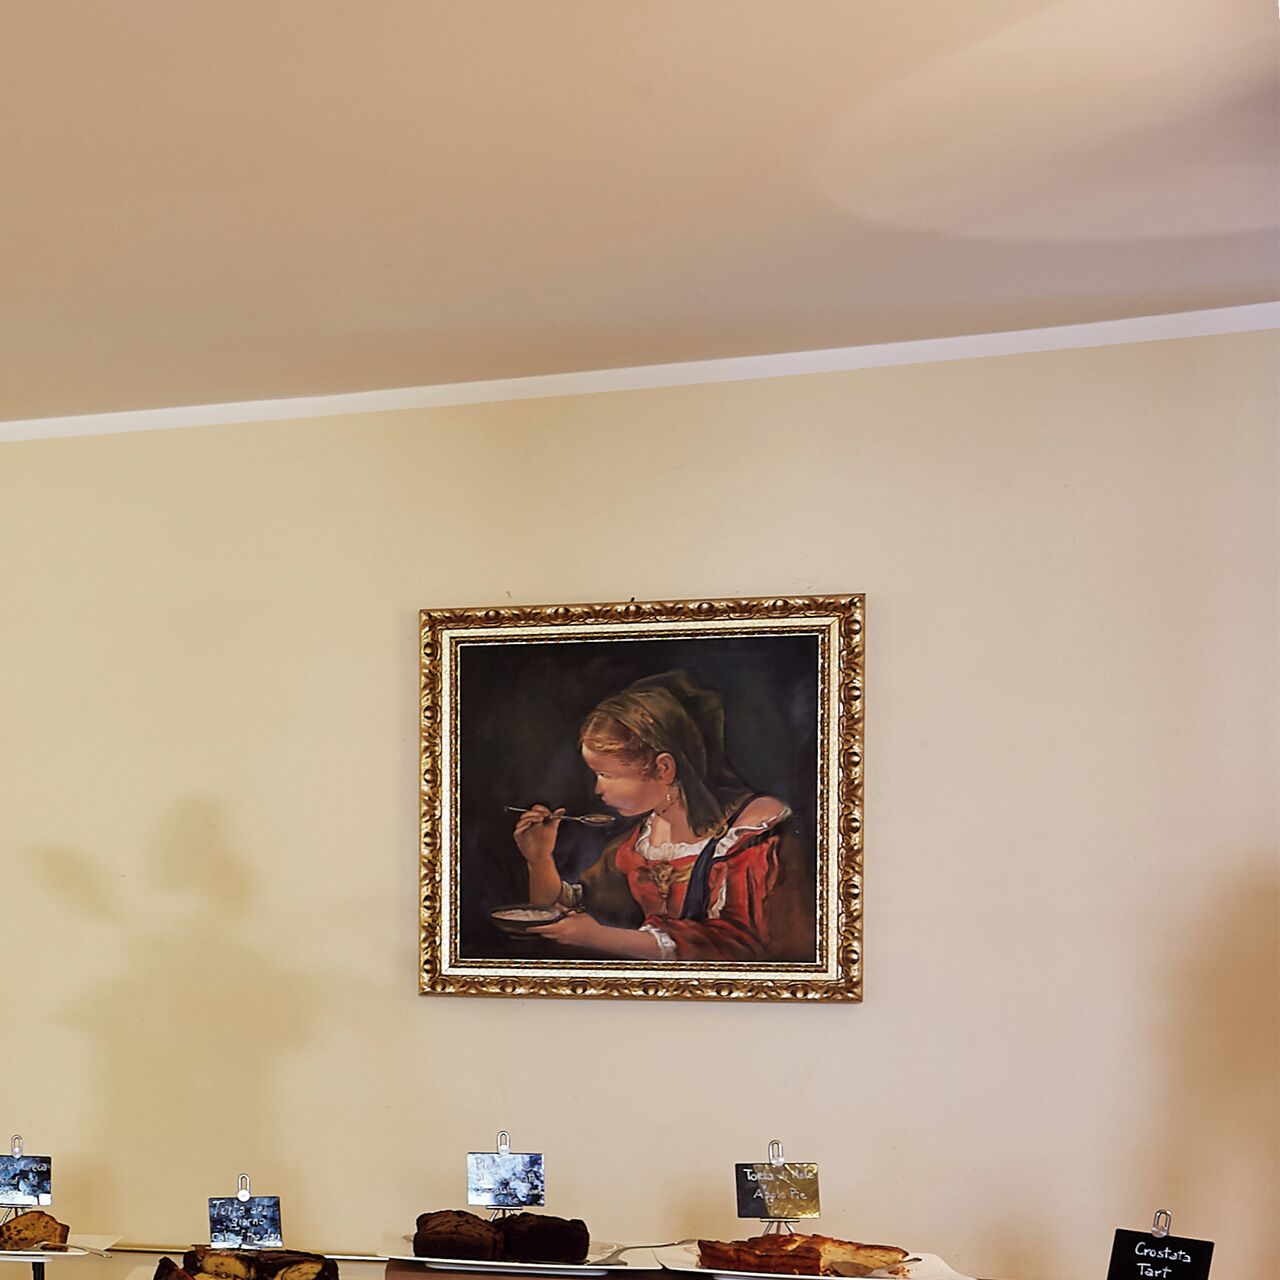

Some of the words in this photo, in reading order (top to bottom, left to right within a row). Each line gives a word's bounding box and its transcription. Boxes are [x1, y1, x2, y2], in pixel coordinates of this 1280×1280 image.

[789, 1187, 808, 1200] Pie
[212, 1200, 245, 1218] Torta
[1135, 1241, 1191, 1262] Crostata
[1136, 1263, 1172, 1279] Tart
